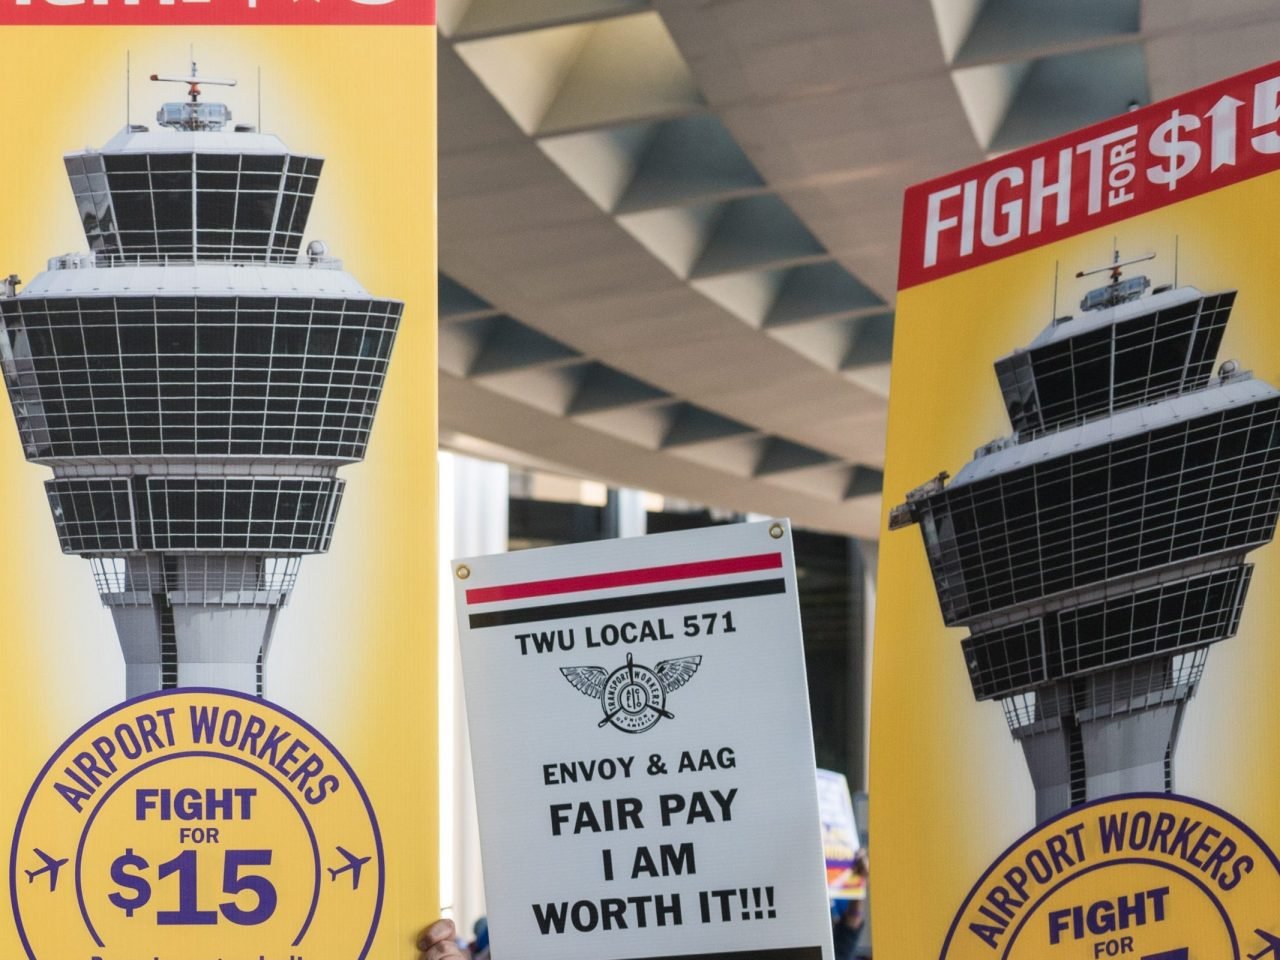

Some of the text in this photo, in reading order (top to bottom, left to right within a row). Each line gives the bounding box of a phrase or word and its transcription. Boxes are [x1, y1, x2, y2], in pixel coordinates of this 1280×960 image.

[923, 124, 1139, 269] FIGHT FOR
[514, 611, 736, 656] TWU LOCAL 571
[608, 671, 660, 712] TRANSPORT WORKERS
[53, 705, 341, 814] AIRPORT WORKERS
[542, 746, 737, 786] ENVOY & AAG
[135, 788, 257, 821] FIGHT
[549, 788, 738, 837] FAIR PAY
[179, 827, 220, 844] FOR
[602, 842, 697, 881] I AM
[968, 811, 1255, 950] AIRPORT WORKERS
[107, 848, 278, 927] $15
[532, 886, 778, 936] WORTH IT!!!
[1048, 886, 1171, 946] FIGHT
[1093, 935, 1135, 960] FOR
